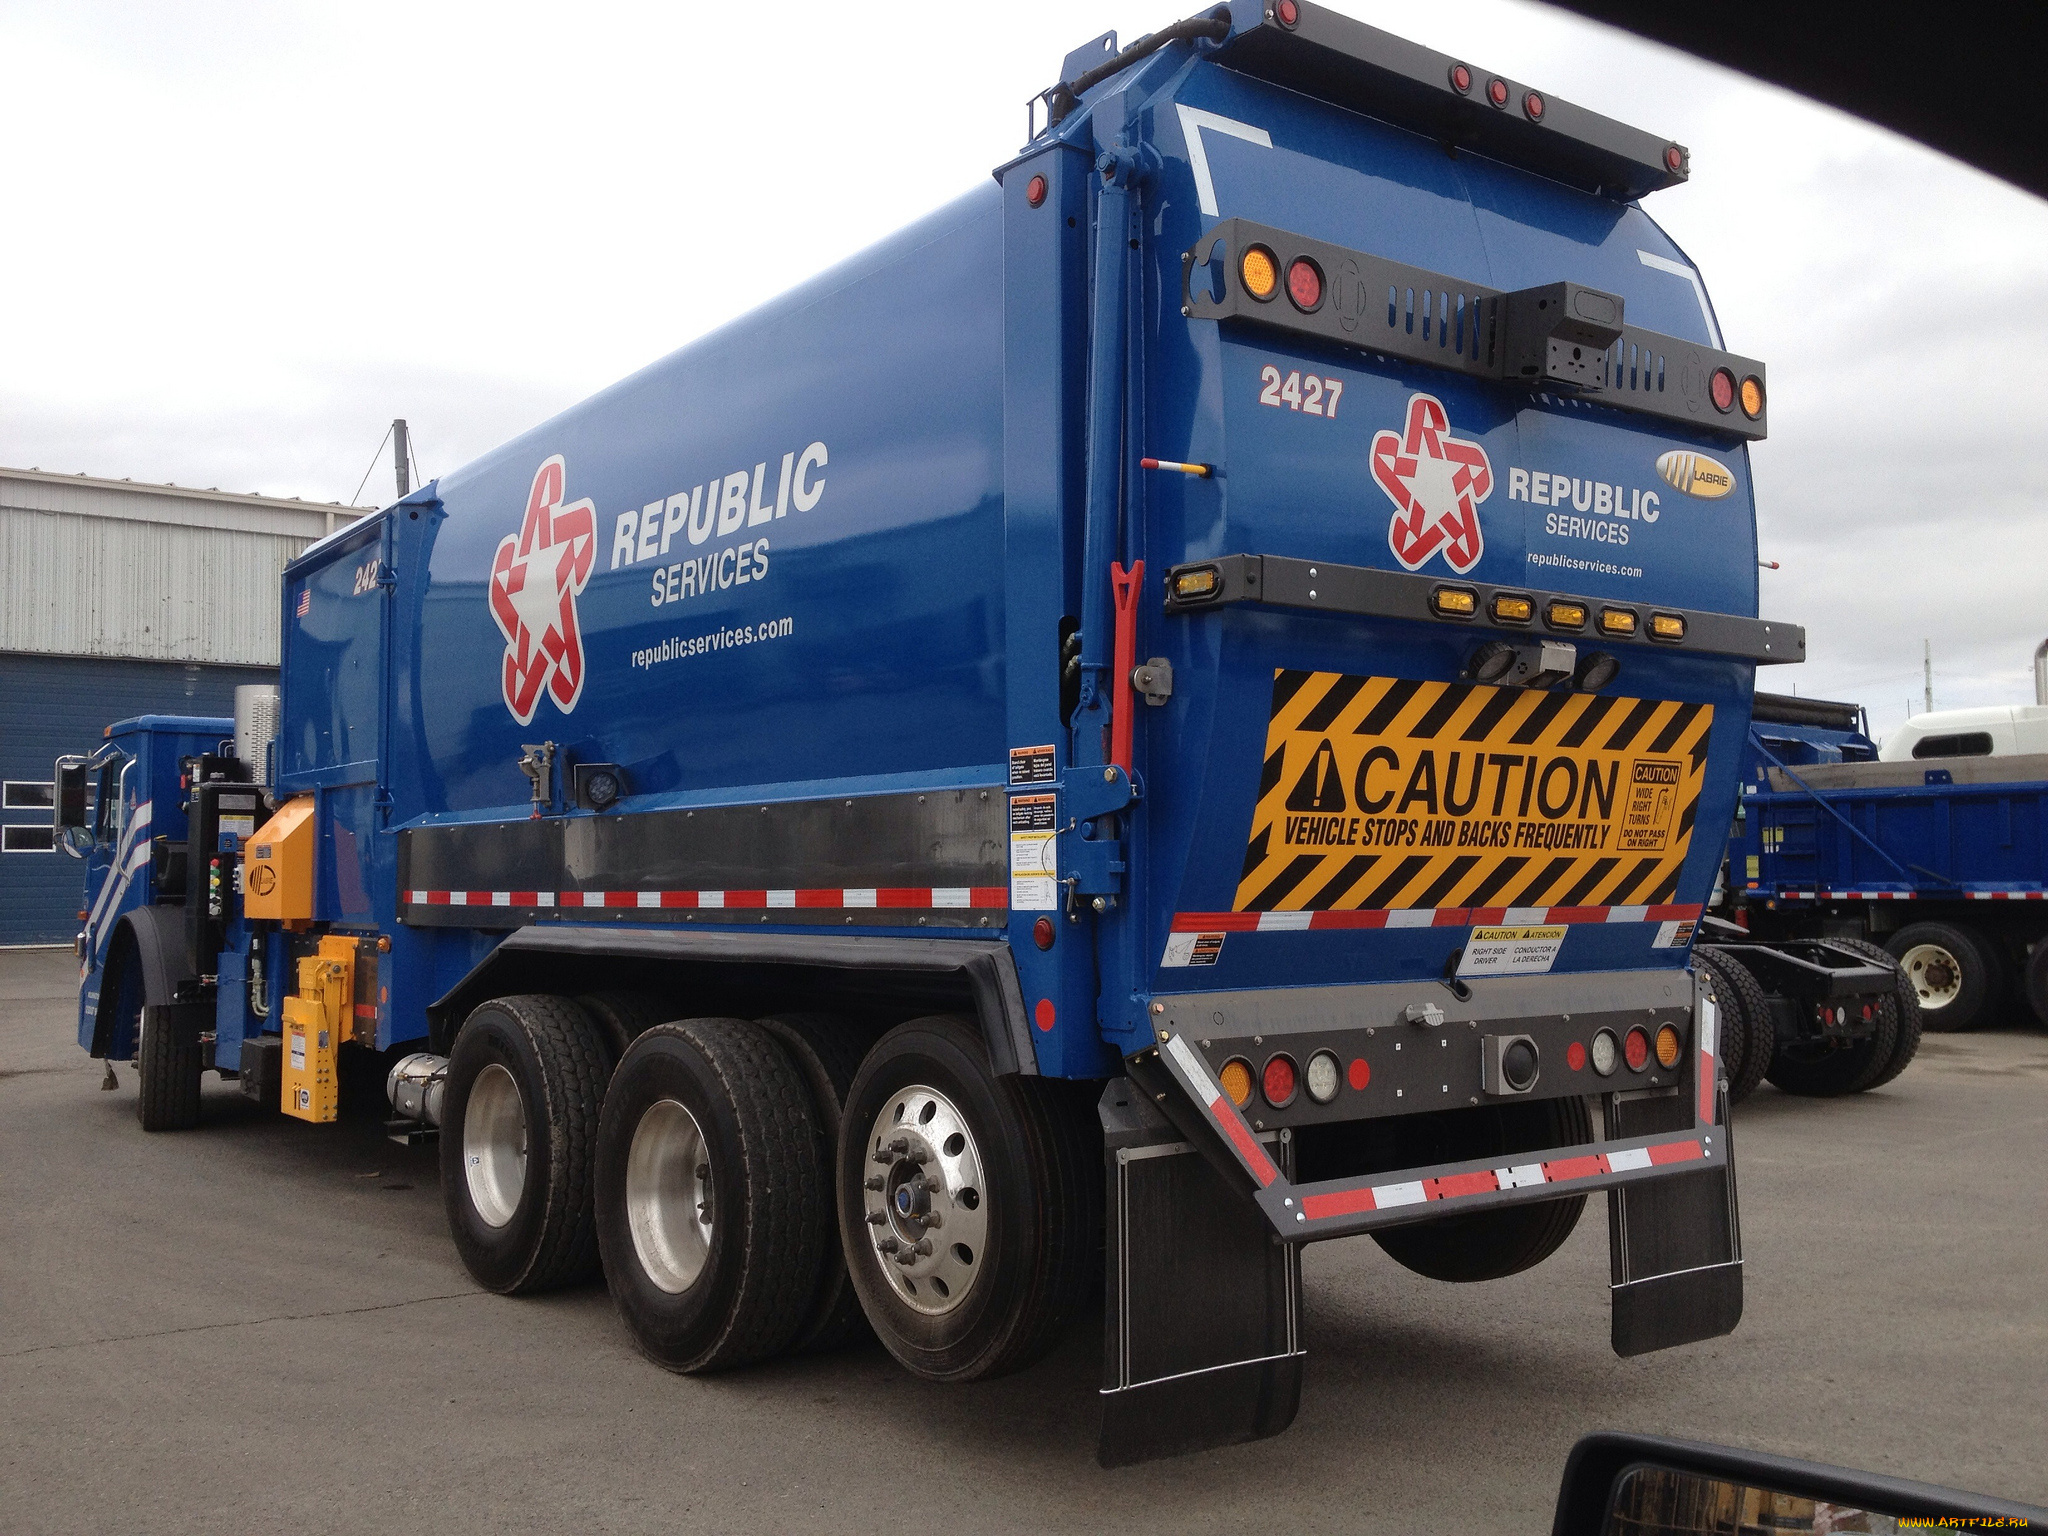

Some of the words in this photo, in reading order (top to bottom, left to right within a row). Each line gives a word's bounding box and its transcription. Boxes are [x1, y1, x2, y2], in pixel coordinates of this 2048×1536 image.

[1259, 364, 1343, 418] 2427
[1694, 470, 1729, 487] LABRIE
[1508, 467, 1660, 523] REPUBLIC
[610, 441, 828, 570] REPUBLIC
[1545, 513, 1630, 546] SERVICES
[651, 538, 769, 607] SERVICES
[1527, 552, 1643, 578] republicservices.com
[353, 558, 382, 595] 242
[631, 616, 793, 670] republicservices.com
[1635, 766, 1678, 782] CAUTION
[1353, 745, 1620, 820] CAUTION
[1636, 787, 1653, 799] WIDE
[1632, 801, 1652, 812] RIGHT
[1628, 814, 1651, 825] TURNS
[1284, 816, 1360, 846] VEHICLE
[1362, 818, 1419, 847] STOPS
[1419, 820, 1453, 847] AND
[1457, 820, 1512, 848] BACKS
[1514, 823, 1611, 852] FREQUENTLY
[1623, 829, 1633, 838] DO
[1634, 829, 1648, 838] NOT
[1648, 829, 1666, 838] PASS
[1627, 838, 1637, 847] ON
[1637, 838, 1658, 847] RIGHT
[1483, 931, 1518, 940] CAUTION
[1472, 948, 1492, 956] RIGHT
[1492, 947, 1507, 955] SIDE
[1513, 946, 1551, 954] CONDUCTOR
[1473, 957, 1498, 965] DRIVER
[1521, 955, 1550, 963] DERECHA
